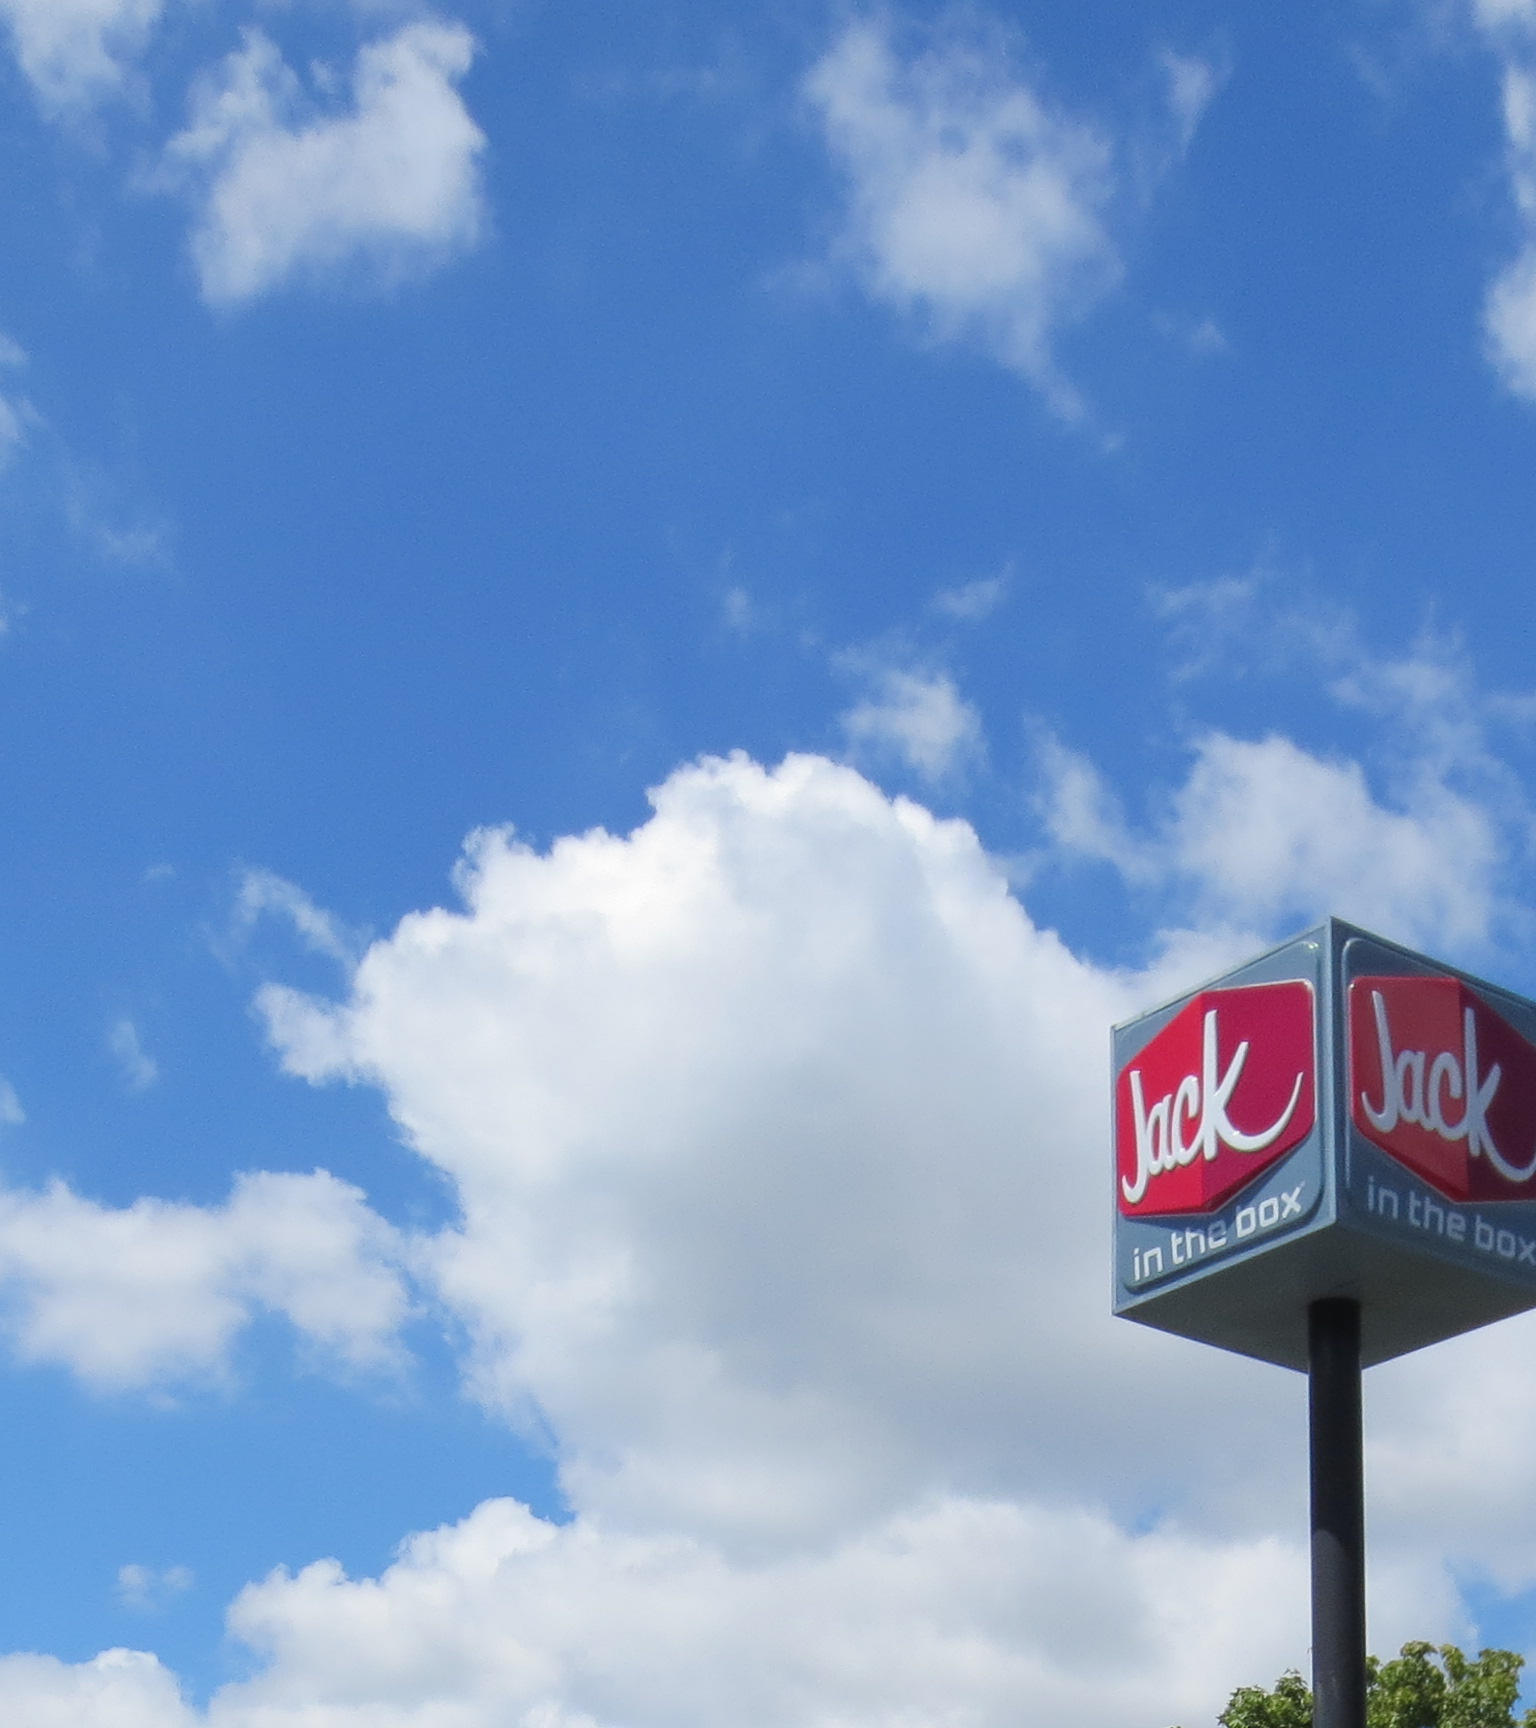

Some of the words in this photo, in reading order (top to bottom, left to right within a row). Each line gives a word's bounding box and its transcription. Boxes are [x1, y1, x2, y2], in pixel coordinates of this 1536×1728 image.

[1122, 1009, 1303, 1204] Jack
[1132, 1247, 1163, 1281] in
[1169, 1216, 1227, 1267] the
[1235, 1190, 1301, 1240] box
[1368, 1175, 1404, 1219] in
[1409, 1191, 1464, 1242] the
